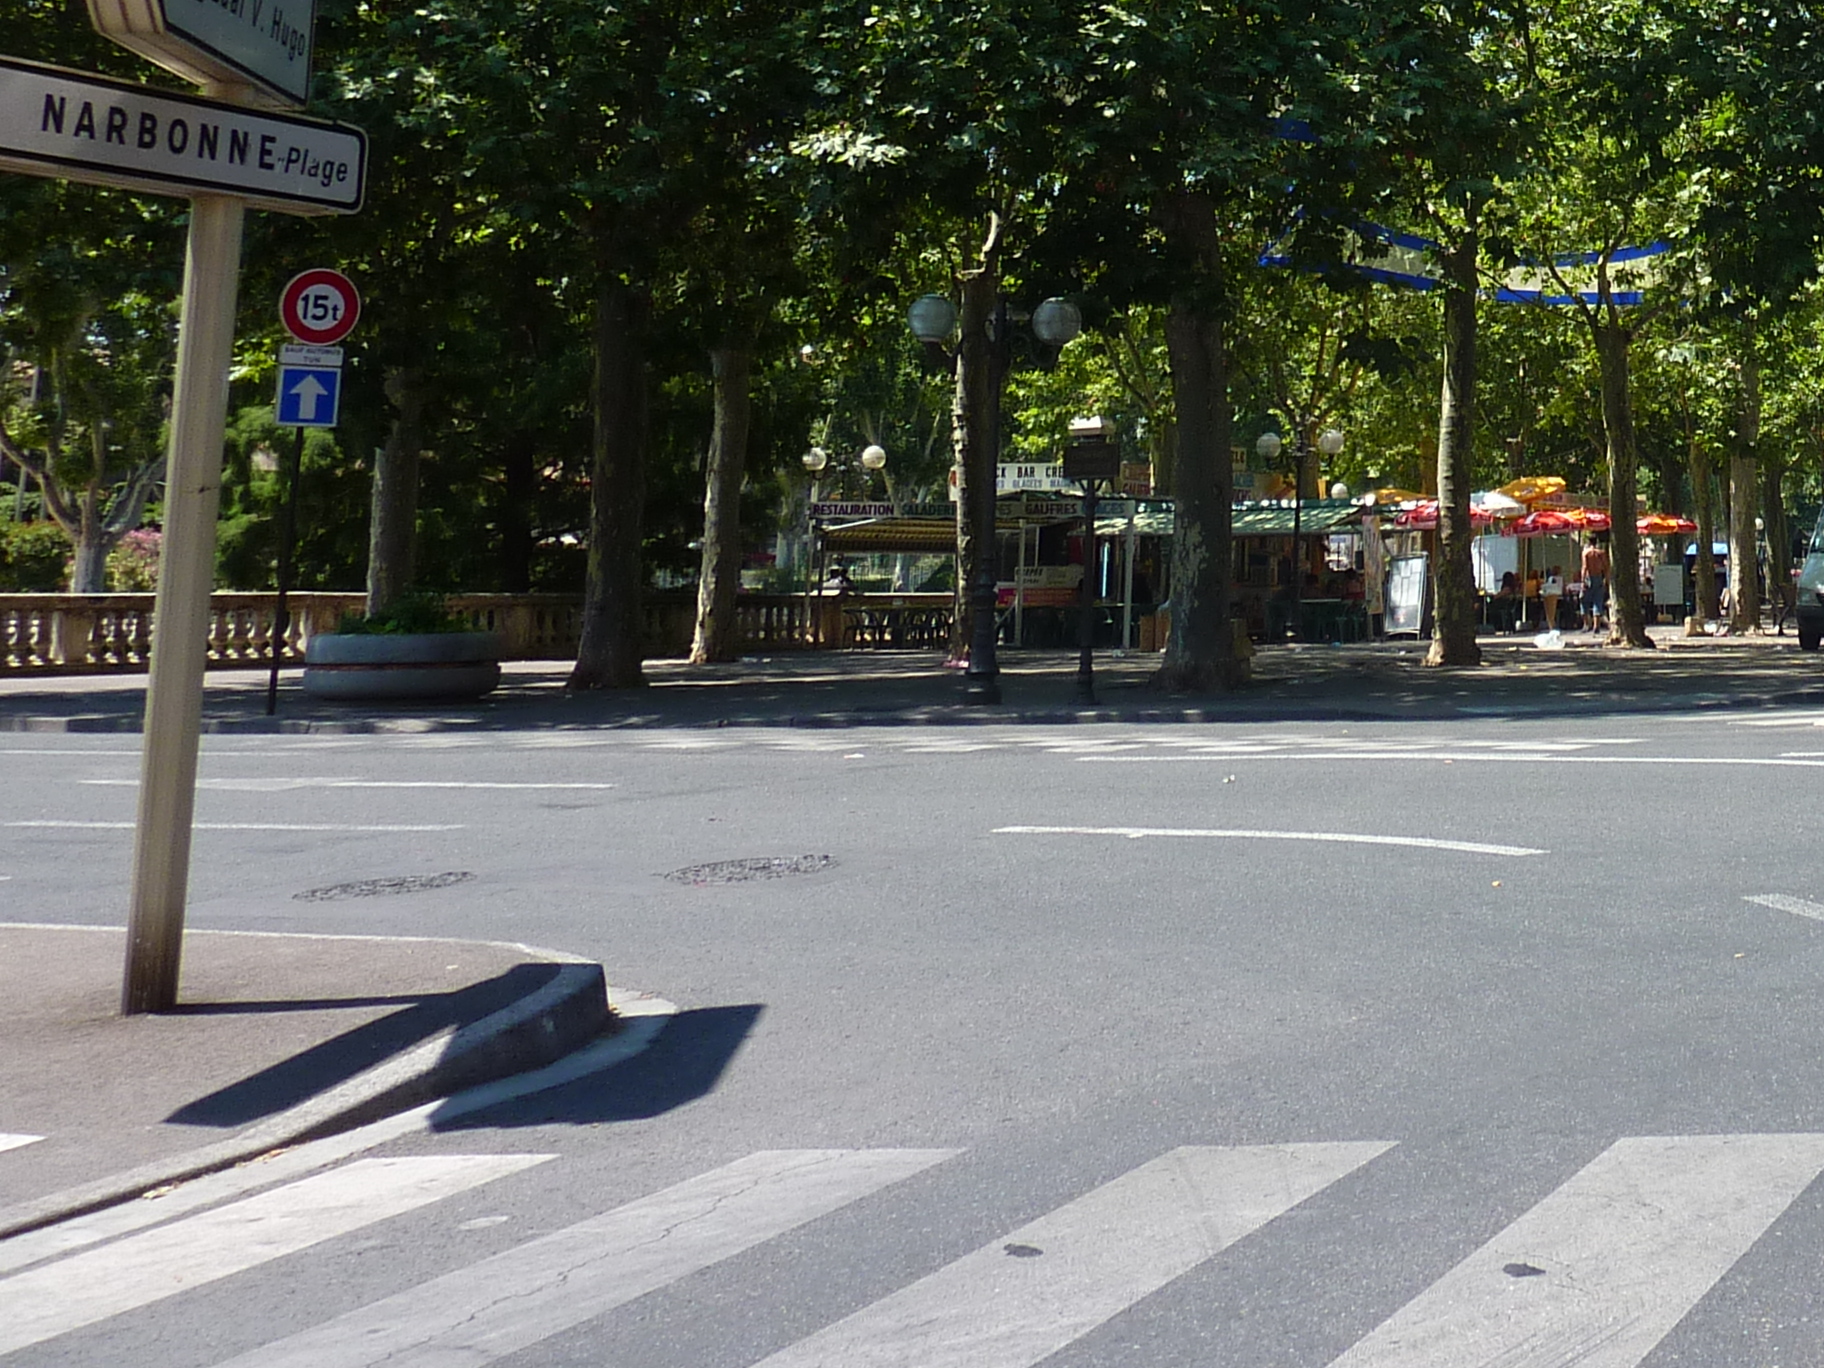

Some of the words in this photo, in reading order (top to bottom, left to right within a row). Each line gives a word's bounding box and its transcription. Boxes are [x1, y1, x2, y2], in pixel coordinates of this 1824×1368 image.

[270, 6, 306, 61] Hugo
[1017, 466, 1035, 478] BAR
[1045, 466, 1064, 478] CRE
[813, 504, 894, 515] RESTAURATION
[902, 504, 956, 516] SALADERI
[1025, 503, 1077, 514] GAUFRES
